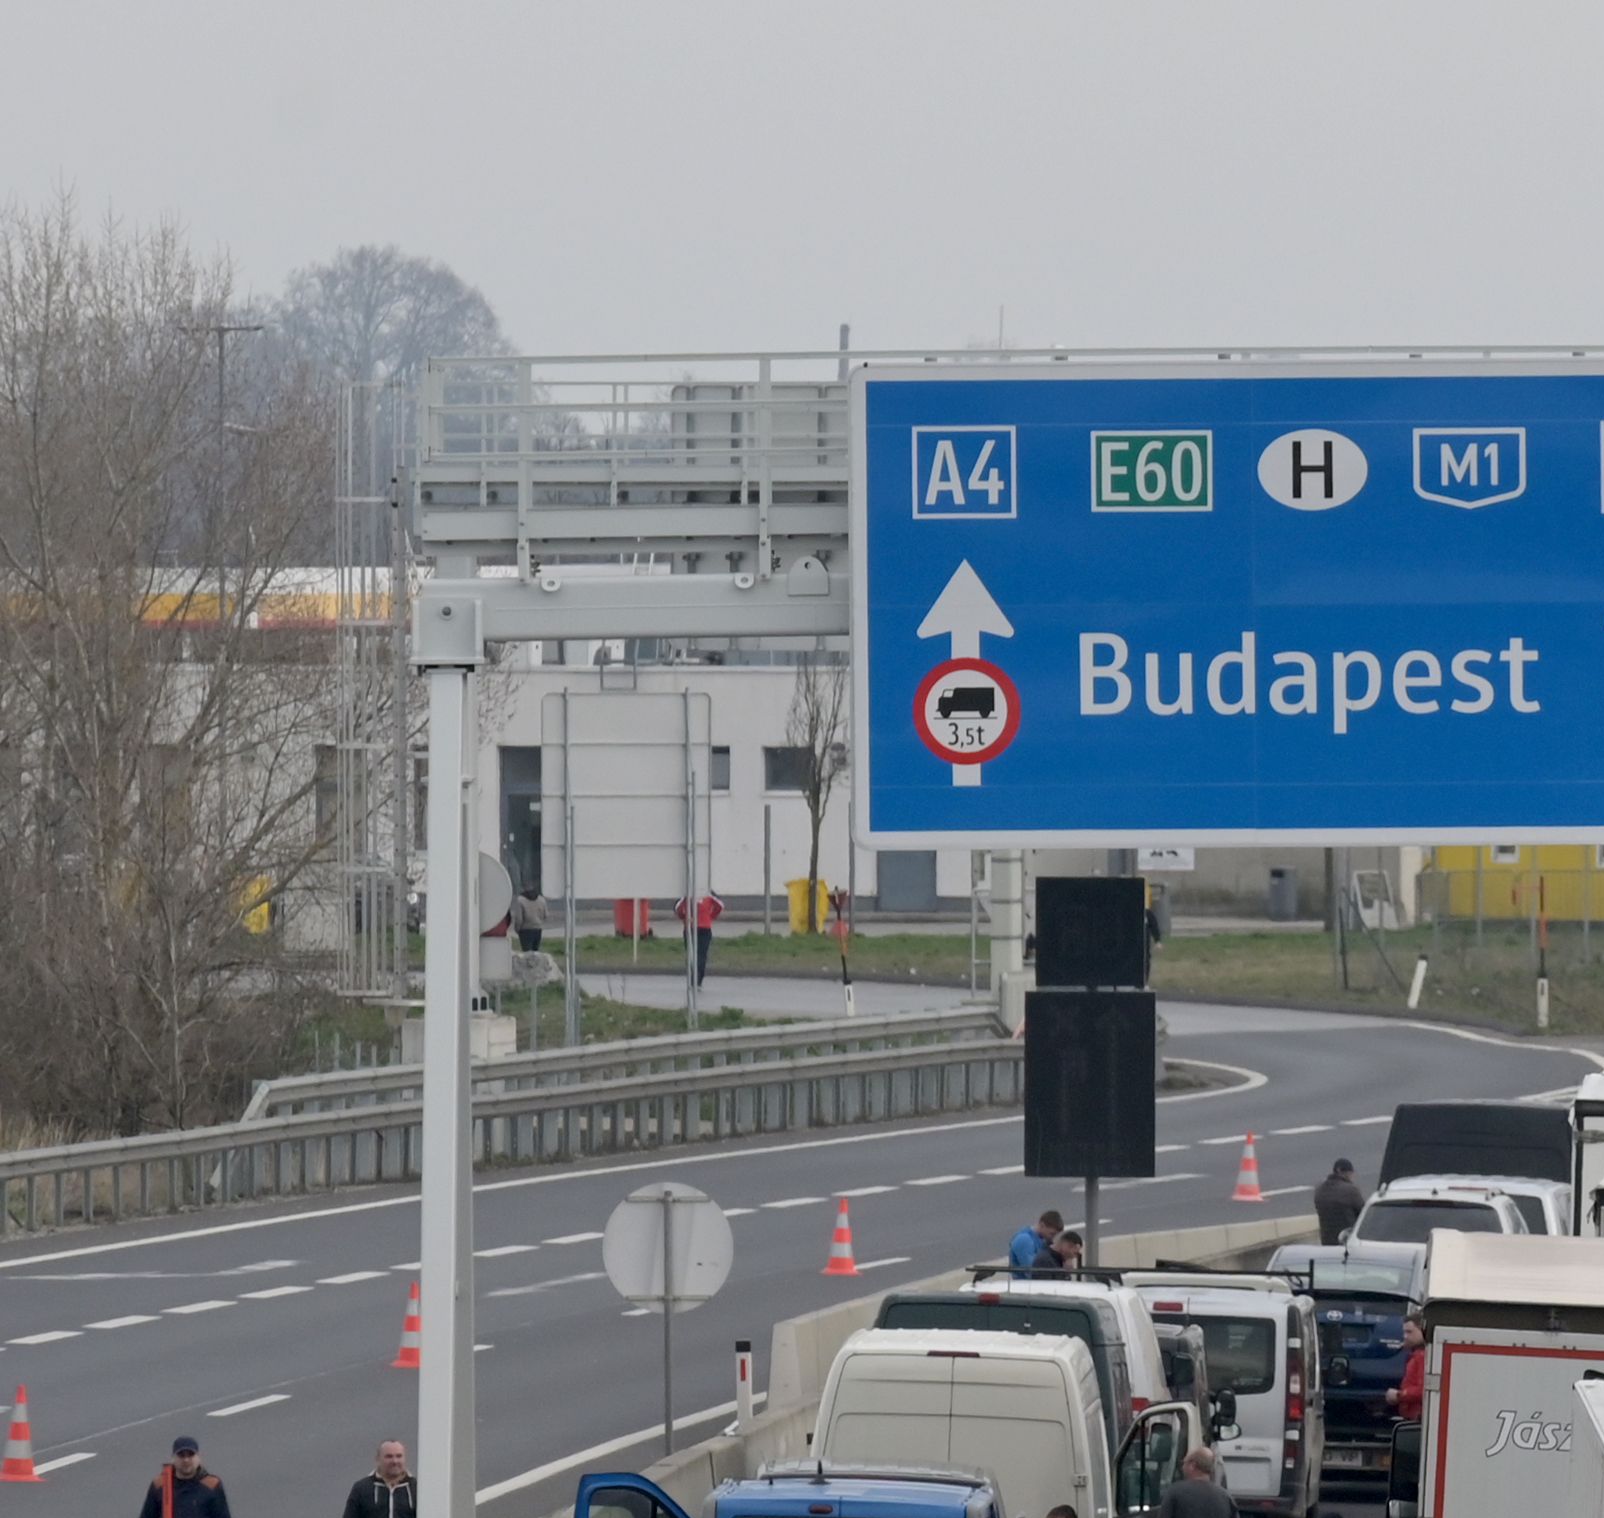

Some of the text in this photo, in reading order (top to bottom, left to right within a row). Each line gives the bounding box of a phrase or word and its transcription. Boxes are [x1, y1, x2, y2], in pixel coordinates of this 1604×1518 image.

[925, 439, 1005, 506] A4
[1101, 440, 1203, 502] E60
[1291, 440, 1334, 499] H
[1440, 442, 1501, 487] M1
[1079, 630, 1541, 734] Budapest
[947, 722, 986, 748] 3,5t
